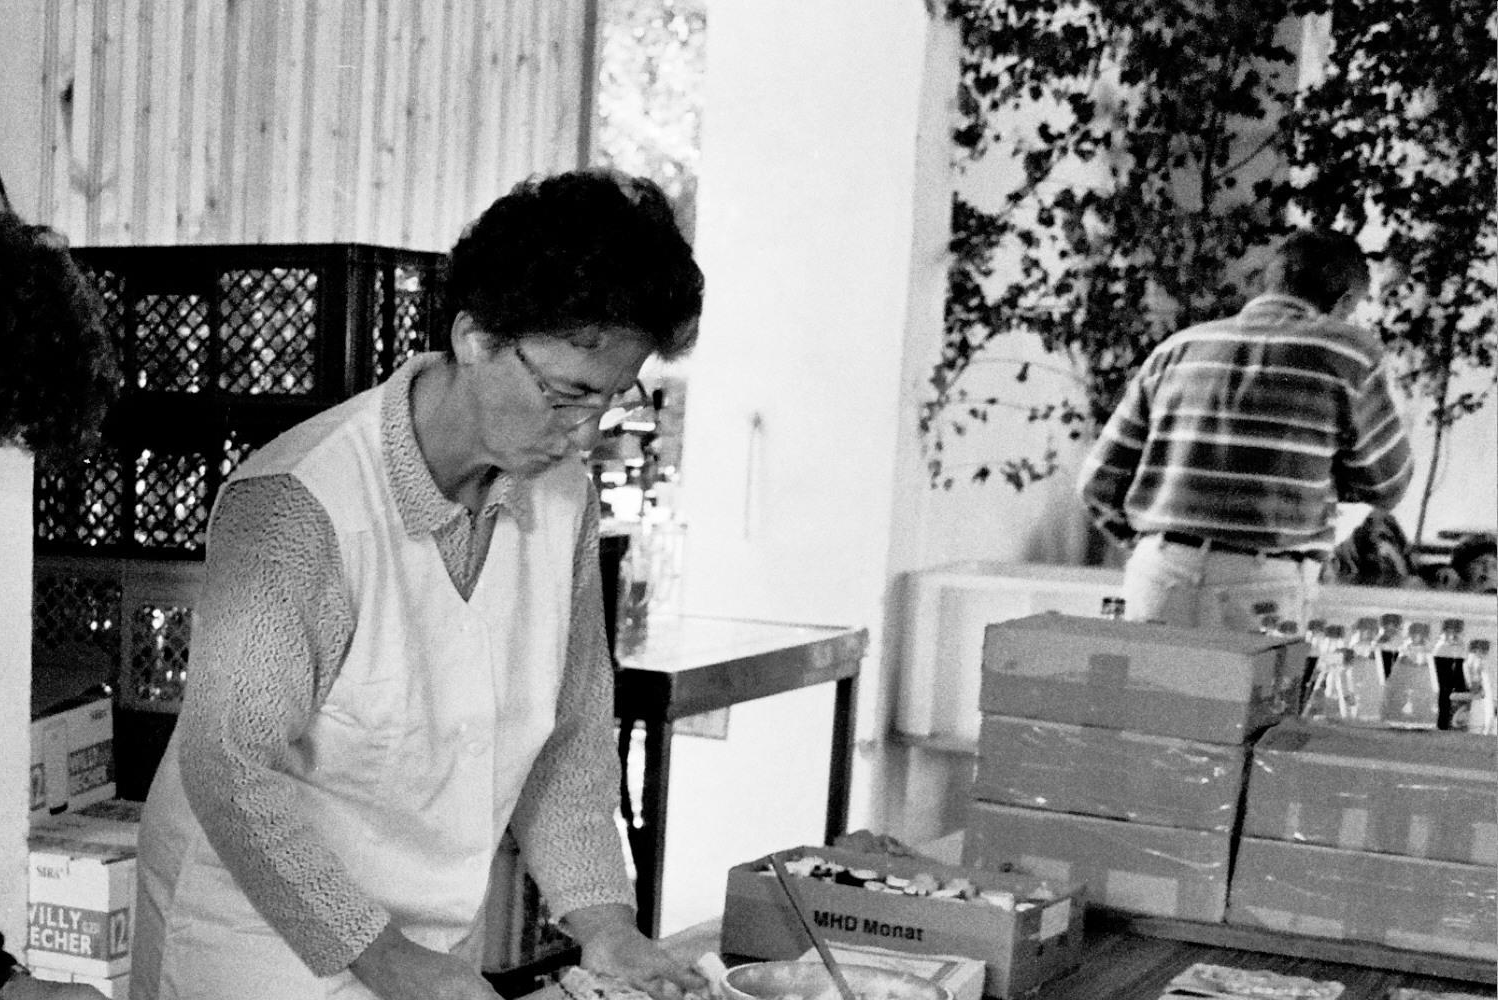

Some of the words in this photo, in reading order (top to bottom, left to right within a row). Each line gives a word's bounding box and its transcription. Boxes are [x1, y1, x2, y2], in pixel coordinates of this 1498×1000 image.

[30, 926, 93, 956] ECHER
[814, 910, 858, 932] MHD
[863, 918, 924, 942] Monat
